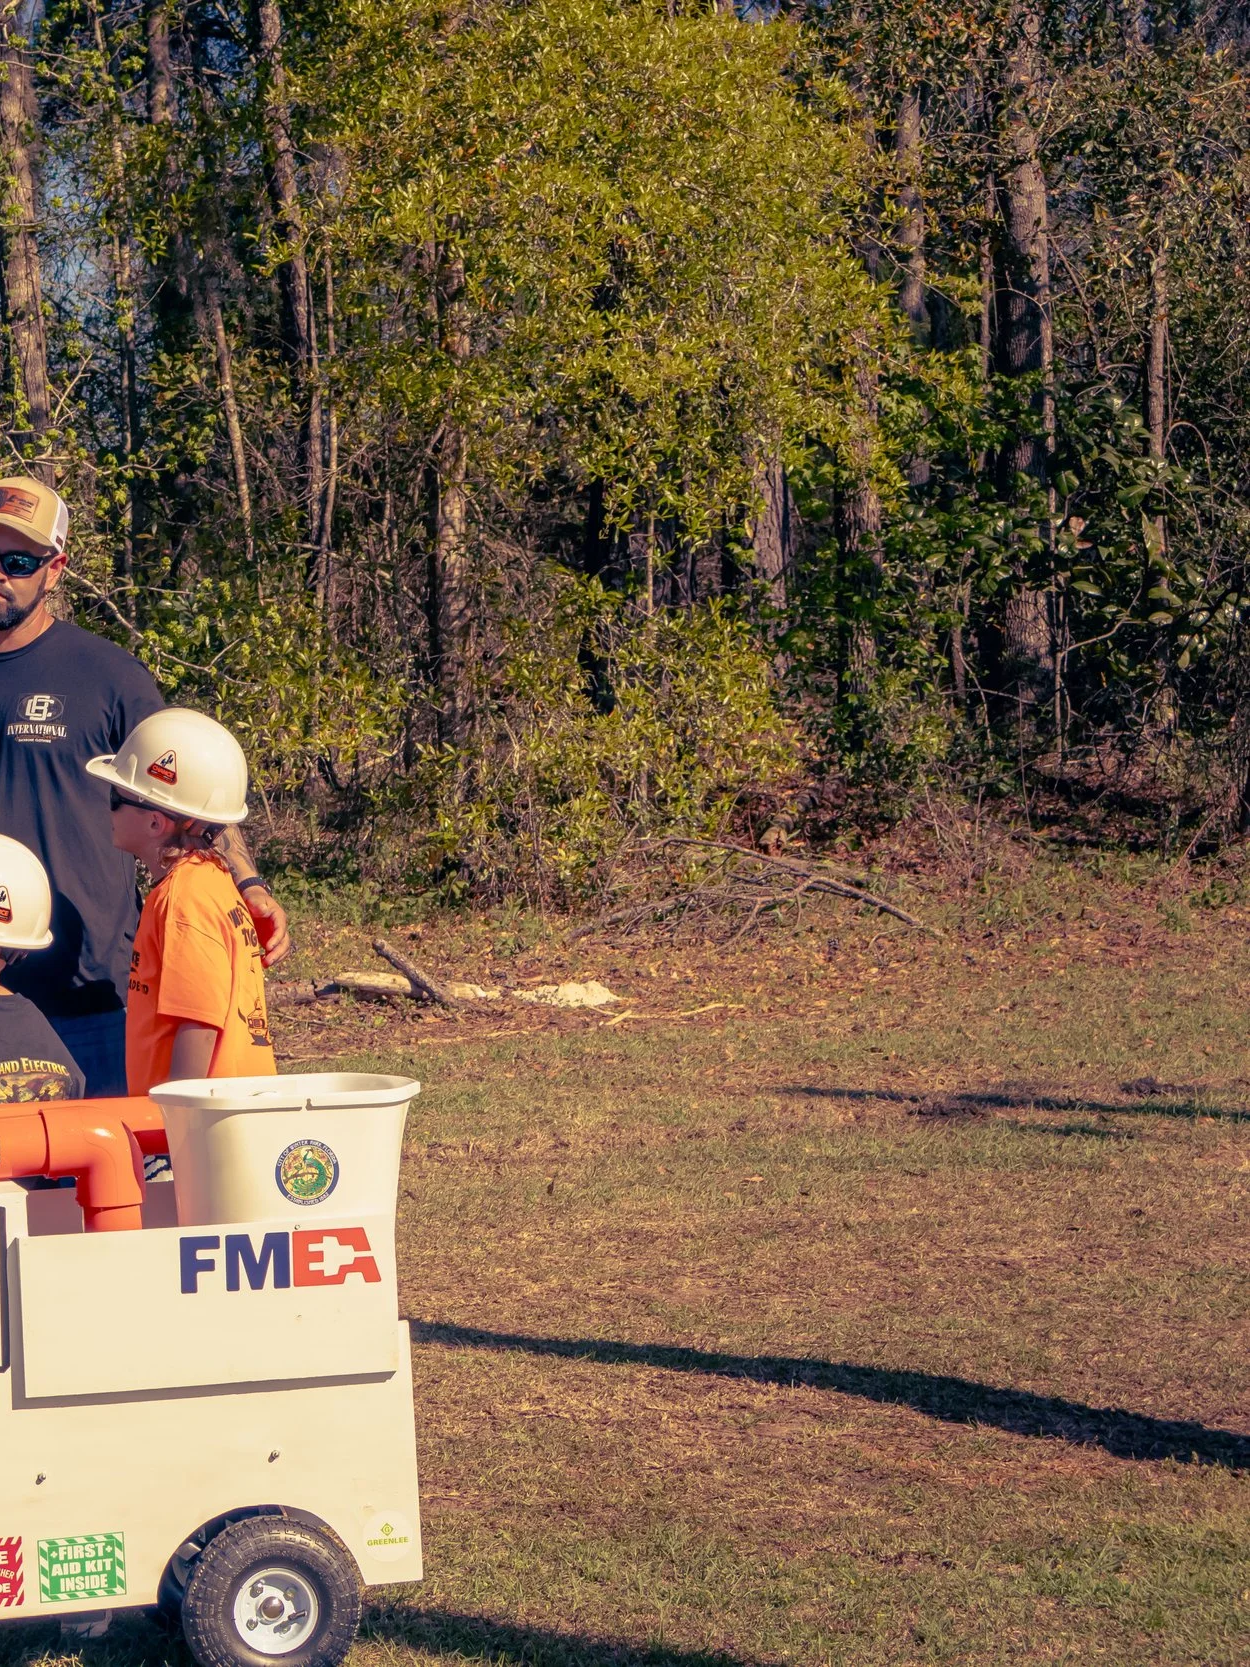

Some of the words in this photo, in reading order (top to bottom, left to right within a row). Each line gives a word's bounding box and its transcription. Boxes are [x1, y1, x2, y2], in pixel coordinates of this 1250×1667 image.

[20, 1057, 70, 1077] ELECTRIC
[179, 1227, 382, 1294] FMEA
[367, 1536, 409, 1547] GREENLEE
[58, 1543, 106, 1561] FIRST
[51, 1562, 82, 1577] AID
[85, 1558, 113, 1573] KIT
[60, 1573, 108, 1593] INSIDE
